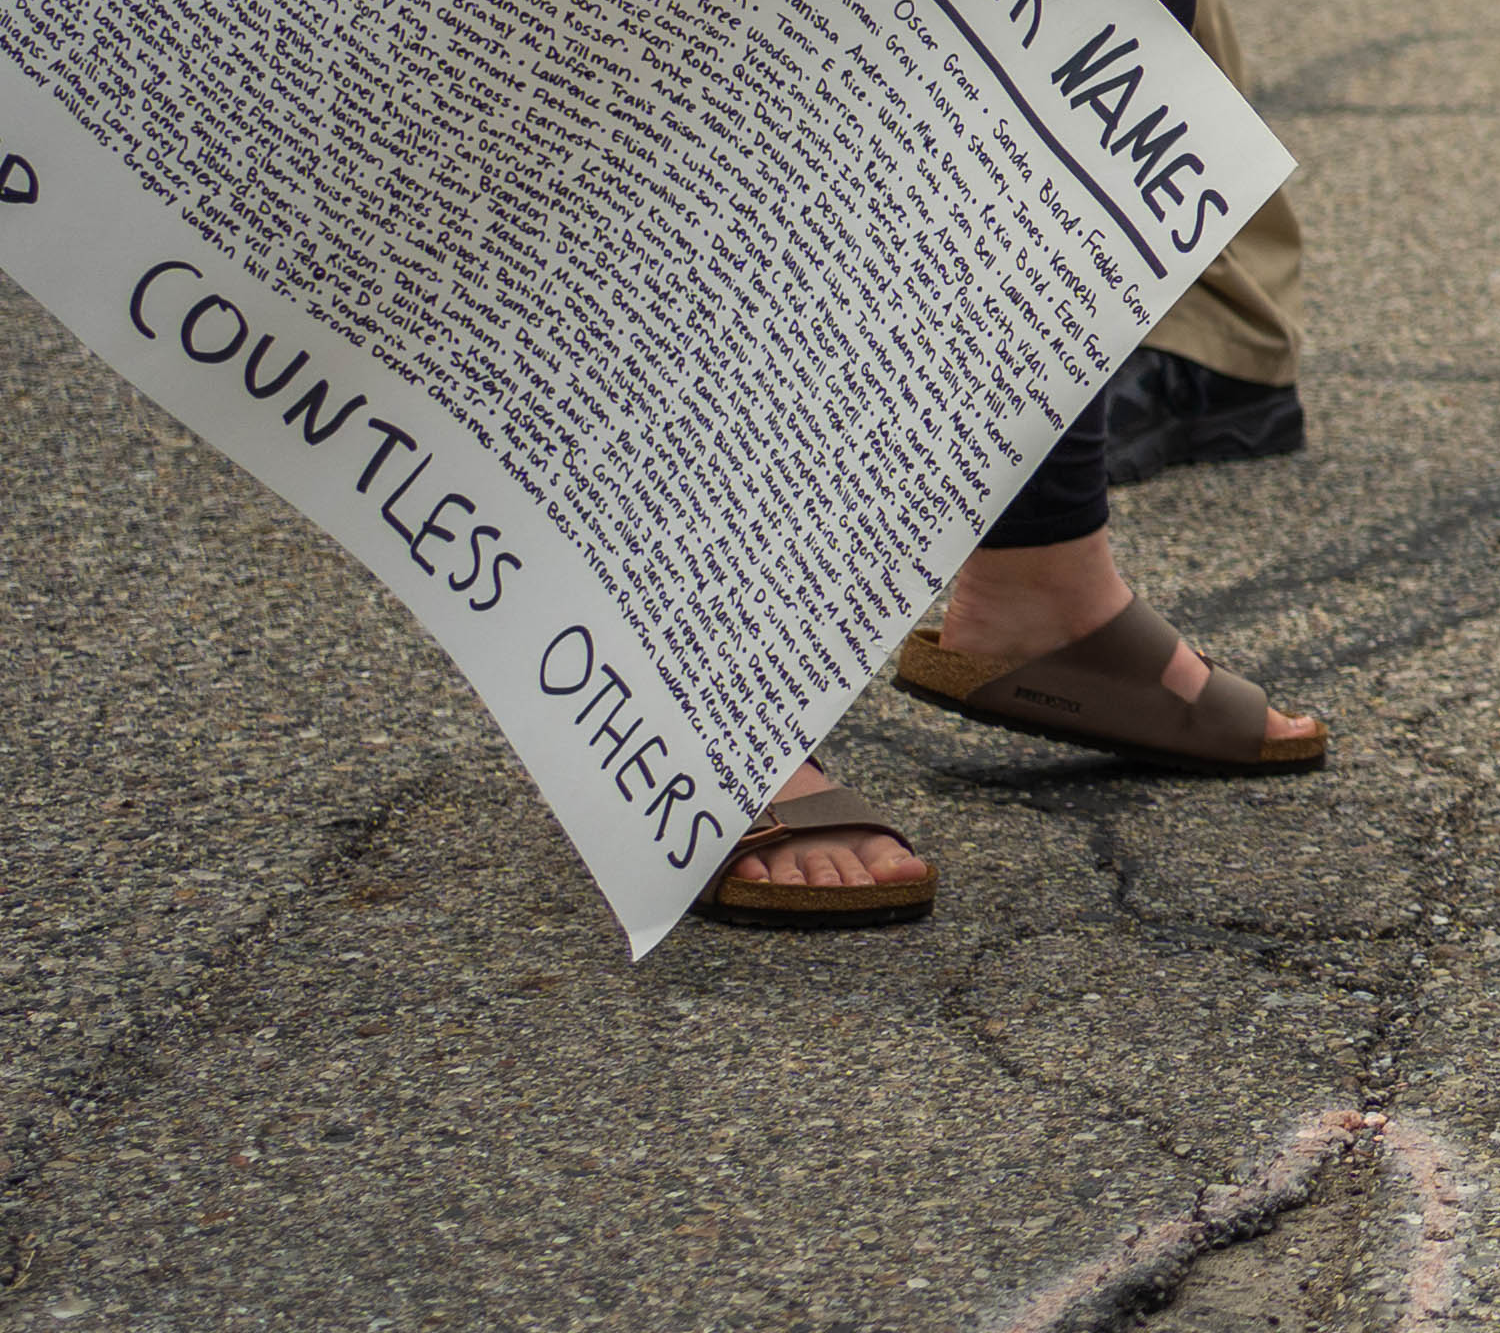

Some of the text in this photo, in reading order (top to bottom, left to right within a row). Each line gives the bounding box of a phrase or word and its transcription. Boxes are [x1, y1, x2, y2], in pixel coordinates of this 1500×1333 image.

[1052, 25, 1229, 253] NAMES
[129, 260, 723, 869] COUNTLESS OTHERS
